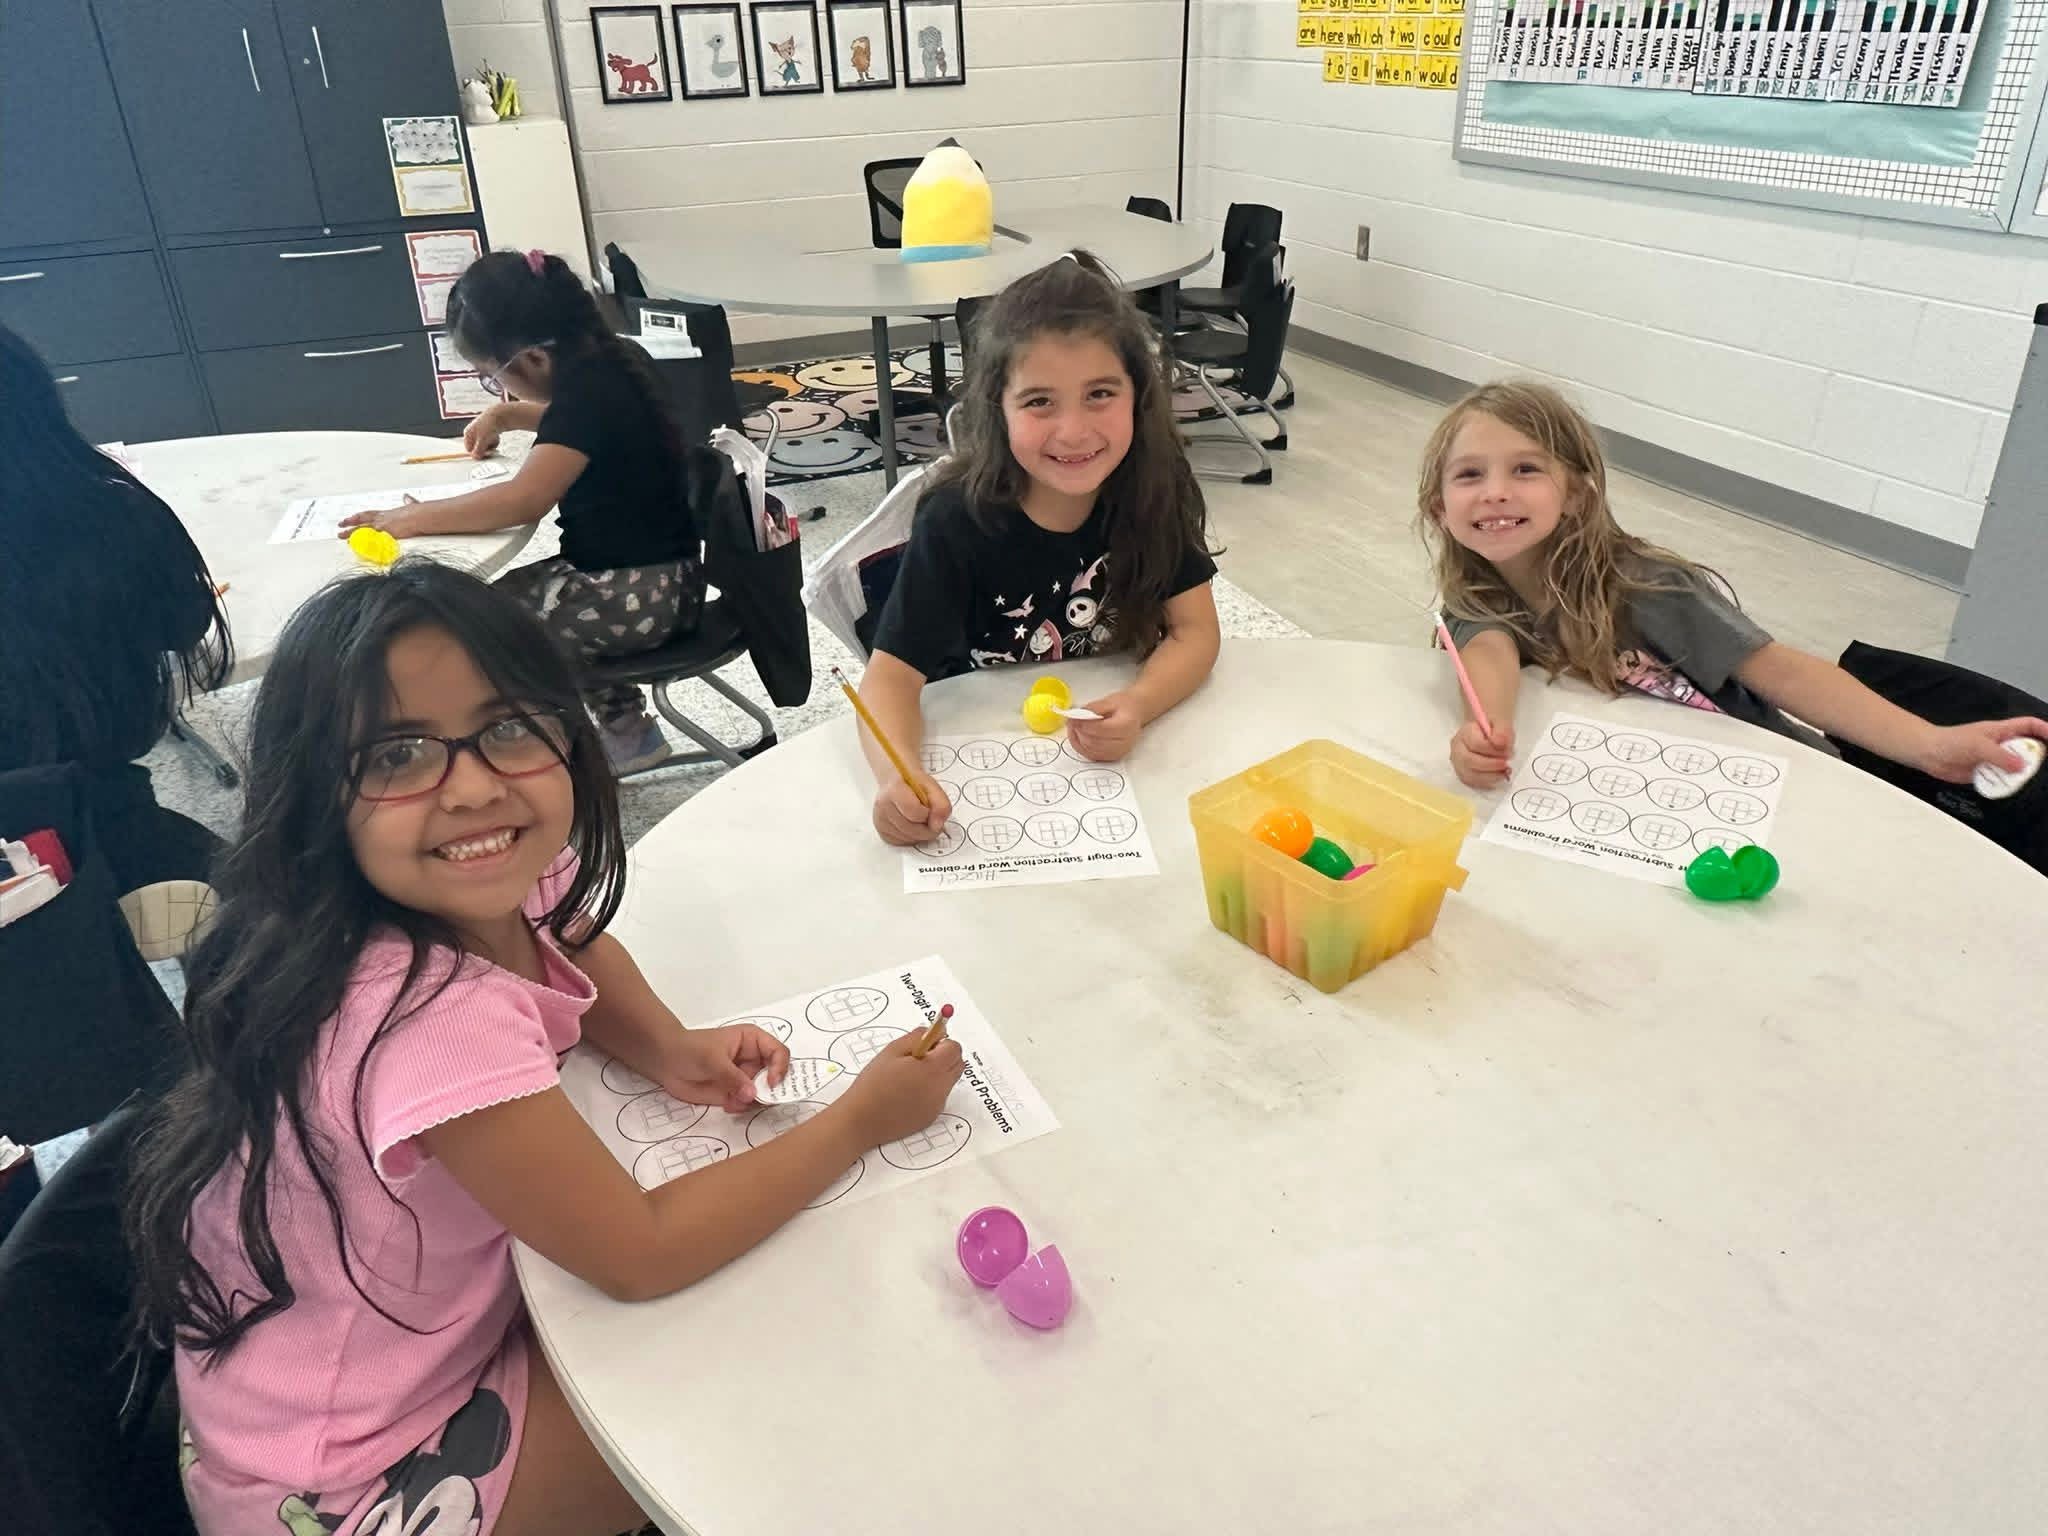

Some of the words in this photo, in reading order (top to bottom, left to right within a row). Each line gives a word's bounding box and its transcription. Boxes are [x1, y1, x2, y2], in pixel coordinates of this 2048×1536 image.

[1300, 28, 1315, 39] are
[1320, 26, 1344, 42] here
[1347, 25, 1383, 44] which
[1390, 27, 1415, 44] two
[1423, 28, 1462, 46] could
[1636, 31, 1649, 67] Thalia
[1594, 40, 1605, 68] Alex
[1650, 38, 1663, 69] Willa
[1679, 35, 1693, 70] Hazel
[1776, 42, 1793, 79] Emily
[1888, 38, 1908, 83] Thalia
[1907, 42, 1926, 81] Willa
[1947, 44, 1966, 83] Hazel
[1327, 58, 1344, 74] to
[1376, 64, 1411, 81] when
[1419, 65, 1458, 84] would
[1503, 823, 1559, 842] Problems
[1563, 838, 1595, 850] Word
[918, 863, 975, 873] Problems
[979, 860, 1010, 870] Word
[1014, 856, 1083, 867] Subtraction
[1088, 851, 1142, 862] Two-Digit
[1600, 847, 1673, 870] Subtraction
[900, 973, 932, 1010] Two-Digit
[976, 1087, 1013, 1133] Problems
